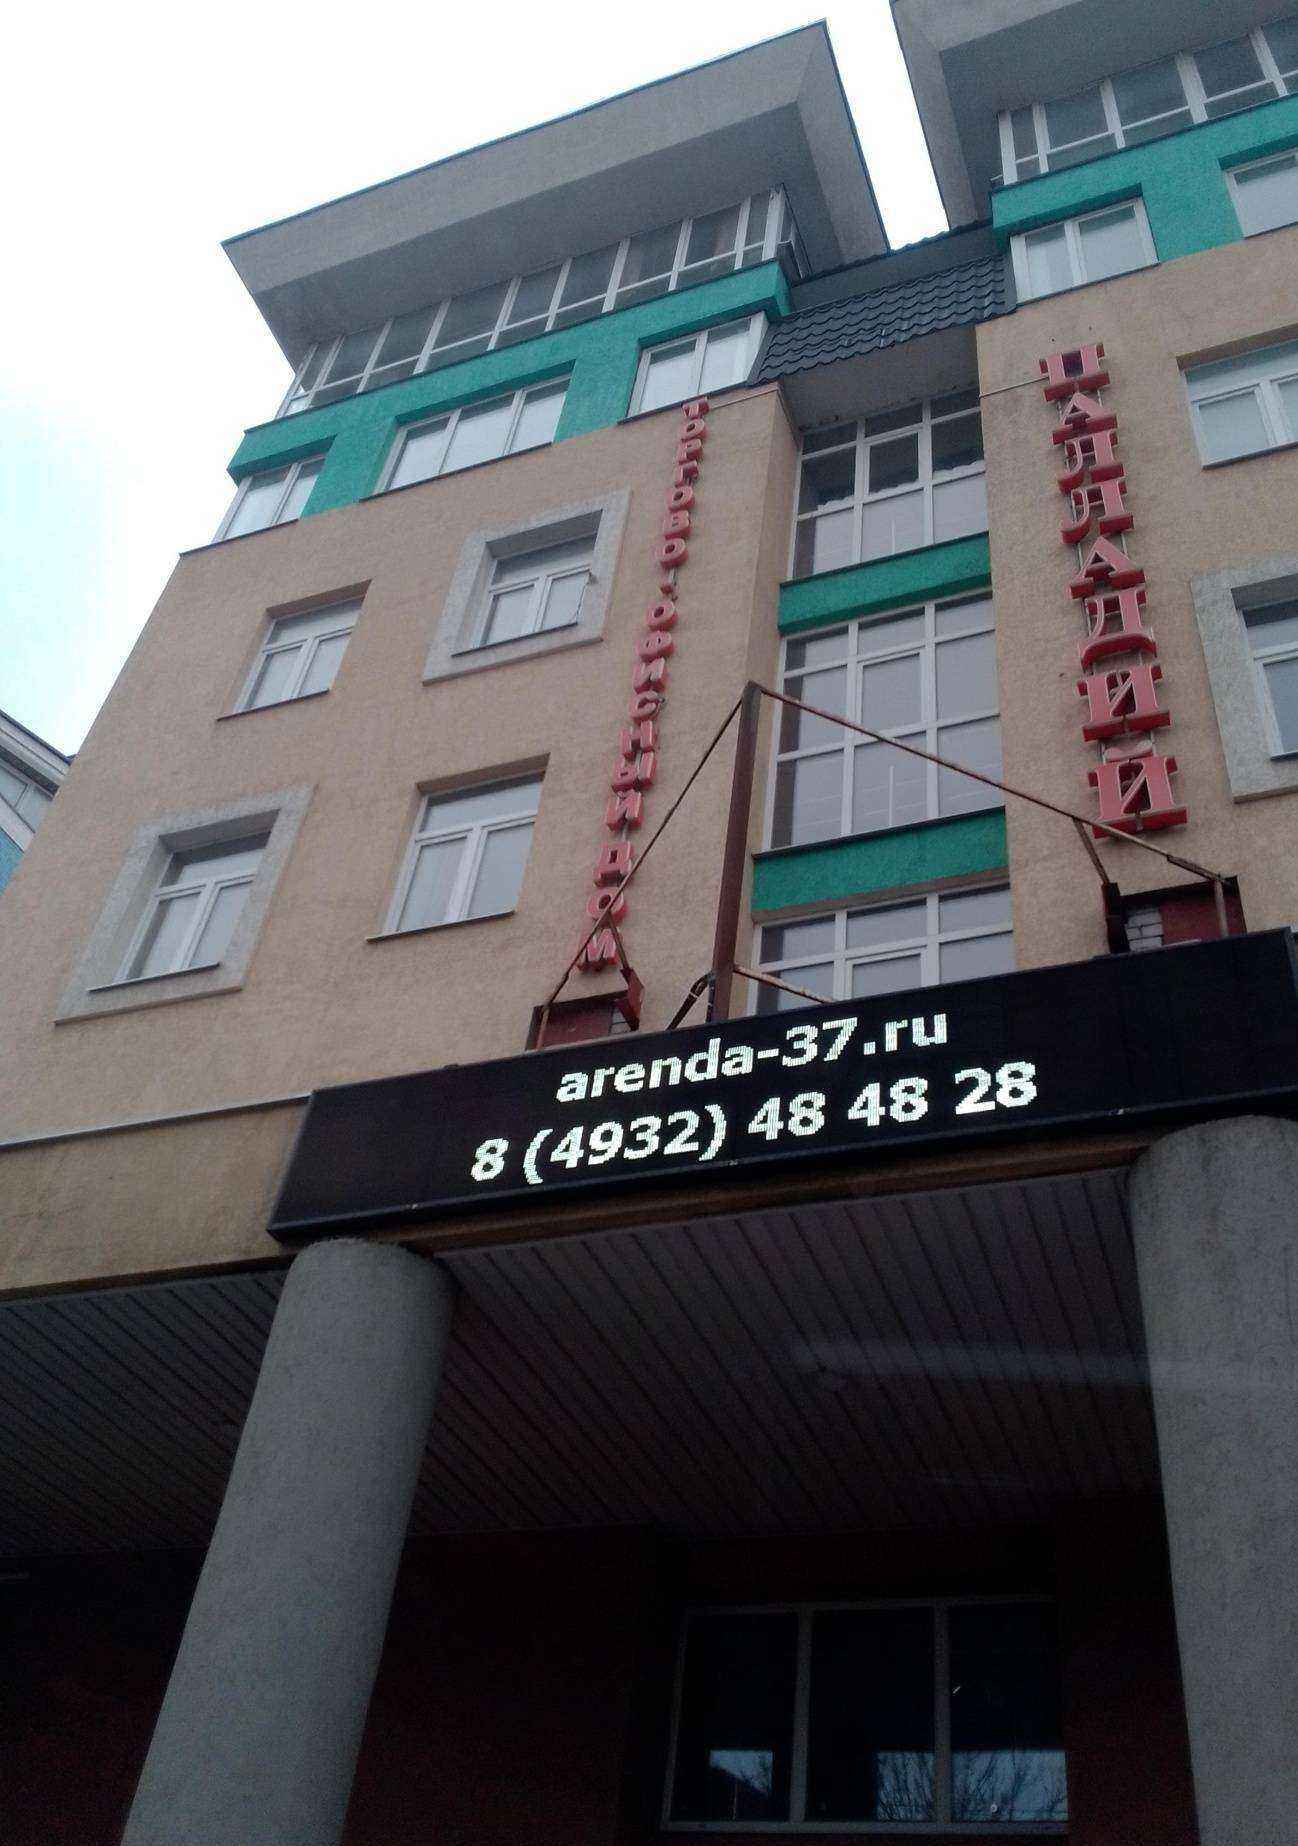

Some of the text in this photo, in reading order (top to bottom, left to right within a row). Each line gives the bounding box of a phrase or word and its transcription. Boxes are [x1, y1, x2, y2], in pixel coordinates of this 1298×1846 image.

[577, 396, 711, 971] ТОРГОВО-ОФИСНЫЙ ДОМ
[1039, 343, 1188, 838] ПАЛЛАДИЙ
[470, 1061, 1038, 1184] 8 (4932) 48 48 28
[556, 1013, 948, 1102] arenda-37.ru
